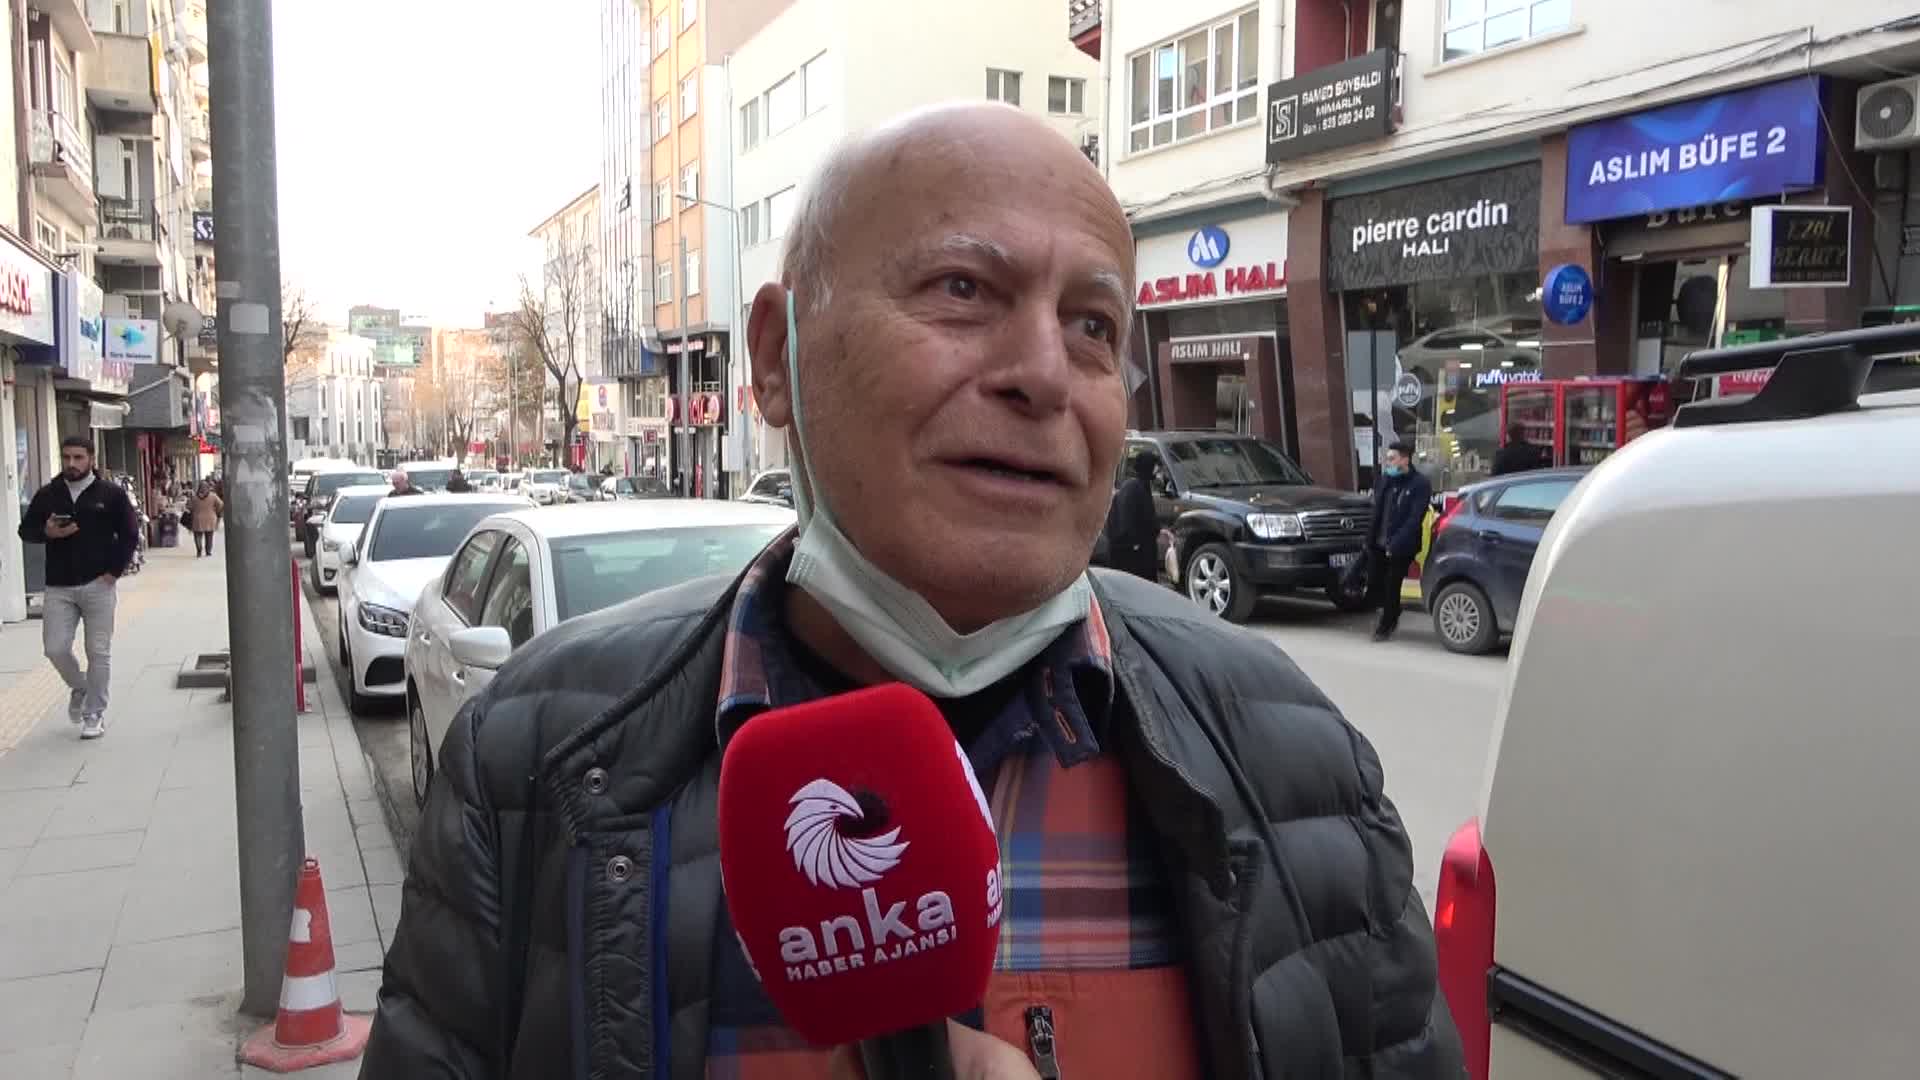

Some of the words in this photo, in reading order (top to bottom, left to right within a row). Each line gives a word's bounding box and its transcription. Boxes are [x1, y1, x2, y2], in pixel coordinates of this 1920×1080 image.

[1589, 147, 1671, 186] ASLIM
[1679, 131, 1758, 170] BÜFE
[1767, 126, 1786, 155] 2
[1352, 216, 1419, 253] pierre
[1426, 199, 1508, 235] cardin
[1402, 237, 1450, 258] HALI
[1138, 271, 1217, 305] ASLIM
[1171, 343, 1208, 360] ASLIM
[1211, 340, 1241, 356] HALI
[1476, 369, 1507, 387] puffy
[779, 887, 955, 963] anka
[786, 953, 866, 982] HABER
[873, 925, 957, 964] AJANSI
